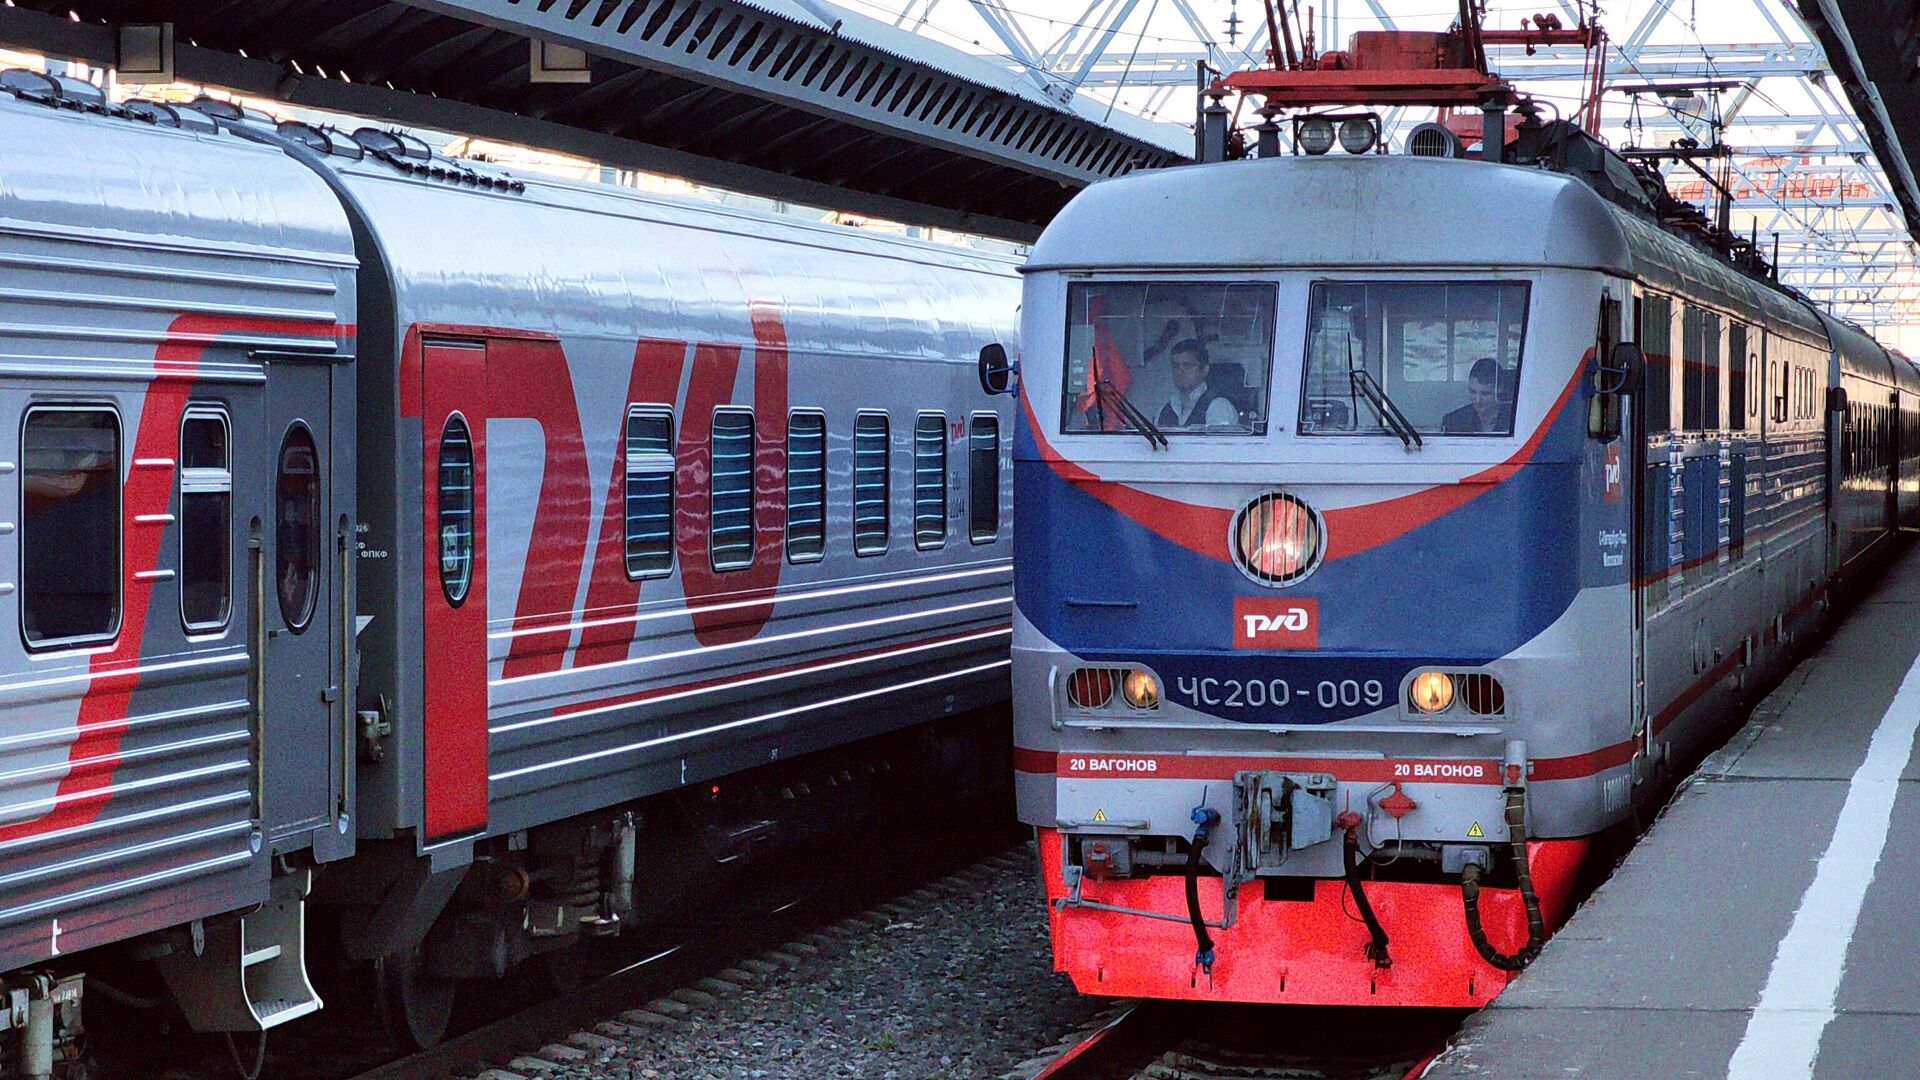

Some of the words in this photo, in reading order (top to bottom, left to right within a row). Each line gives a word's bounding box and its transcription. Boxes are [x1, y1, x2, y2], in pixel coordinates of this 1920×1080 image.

[361, 550, 388, 558] ФПКФ
[1243, 607, 1309, 638] РЖД
[1176, 676, 1384, 709] ЧС200-009
[1070, 758, 1086, 771] 20
[1089, 758, 1157, 772] ВАГОНОВ
[1394, 764, 1411, 776] 20
[1414, 764, 1484, 777] ВАГОНОВ
